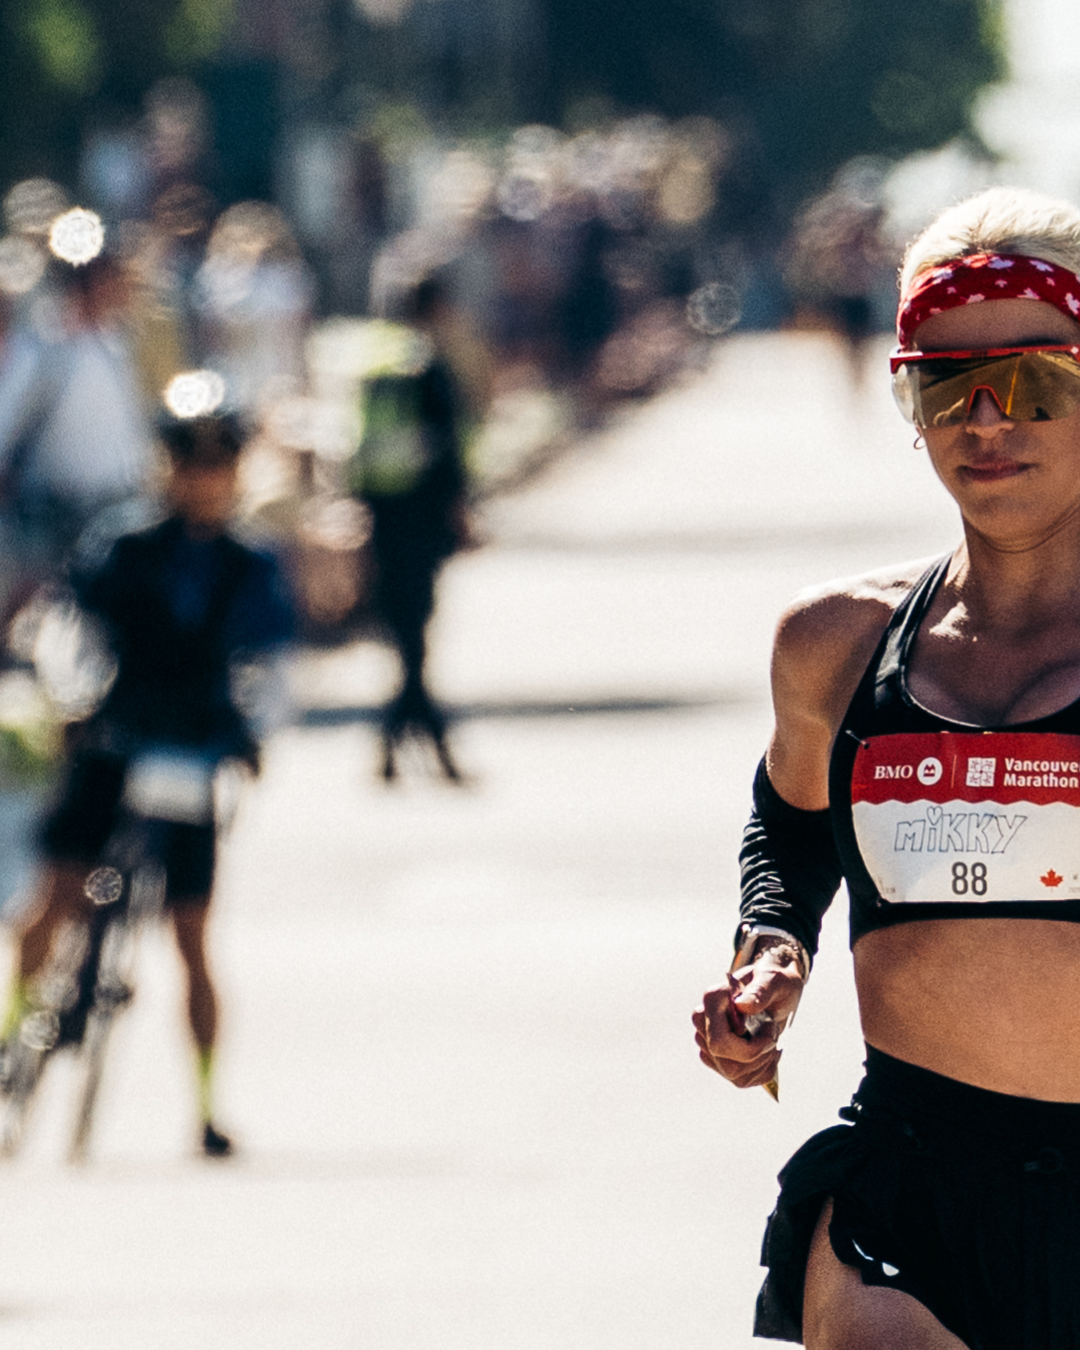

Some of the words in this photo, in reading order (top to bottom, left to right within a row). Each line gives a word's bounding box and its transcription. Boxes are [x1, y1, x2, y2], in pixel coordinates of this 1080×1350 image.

[874, 765, 913, 779] BMO
[1003, 773, 1079, 788] Marathon
[951, 861, 988, 896] 88
